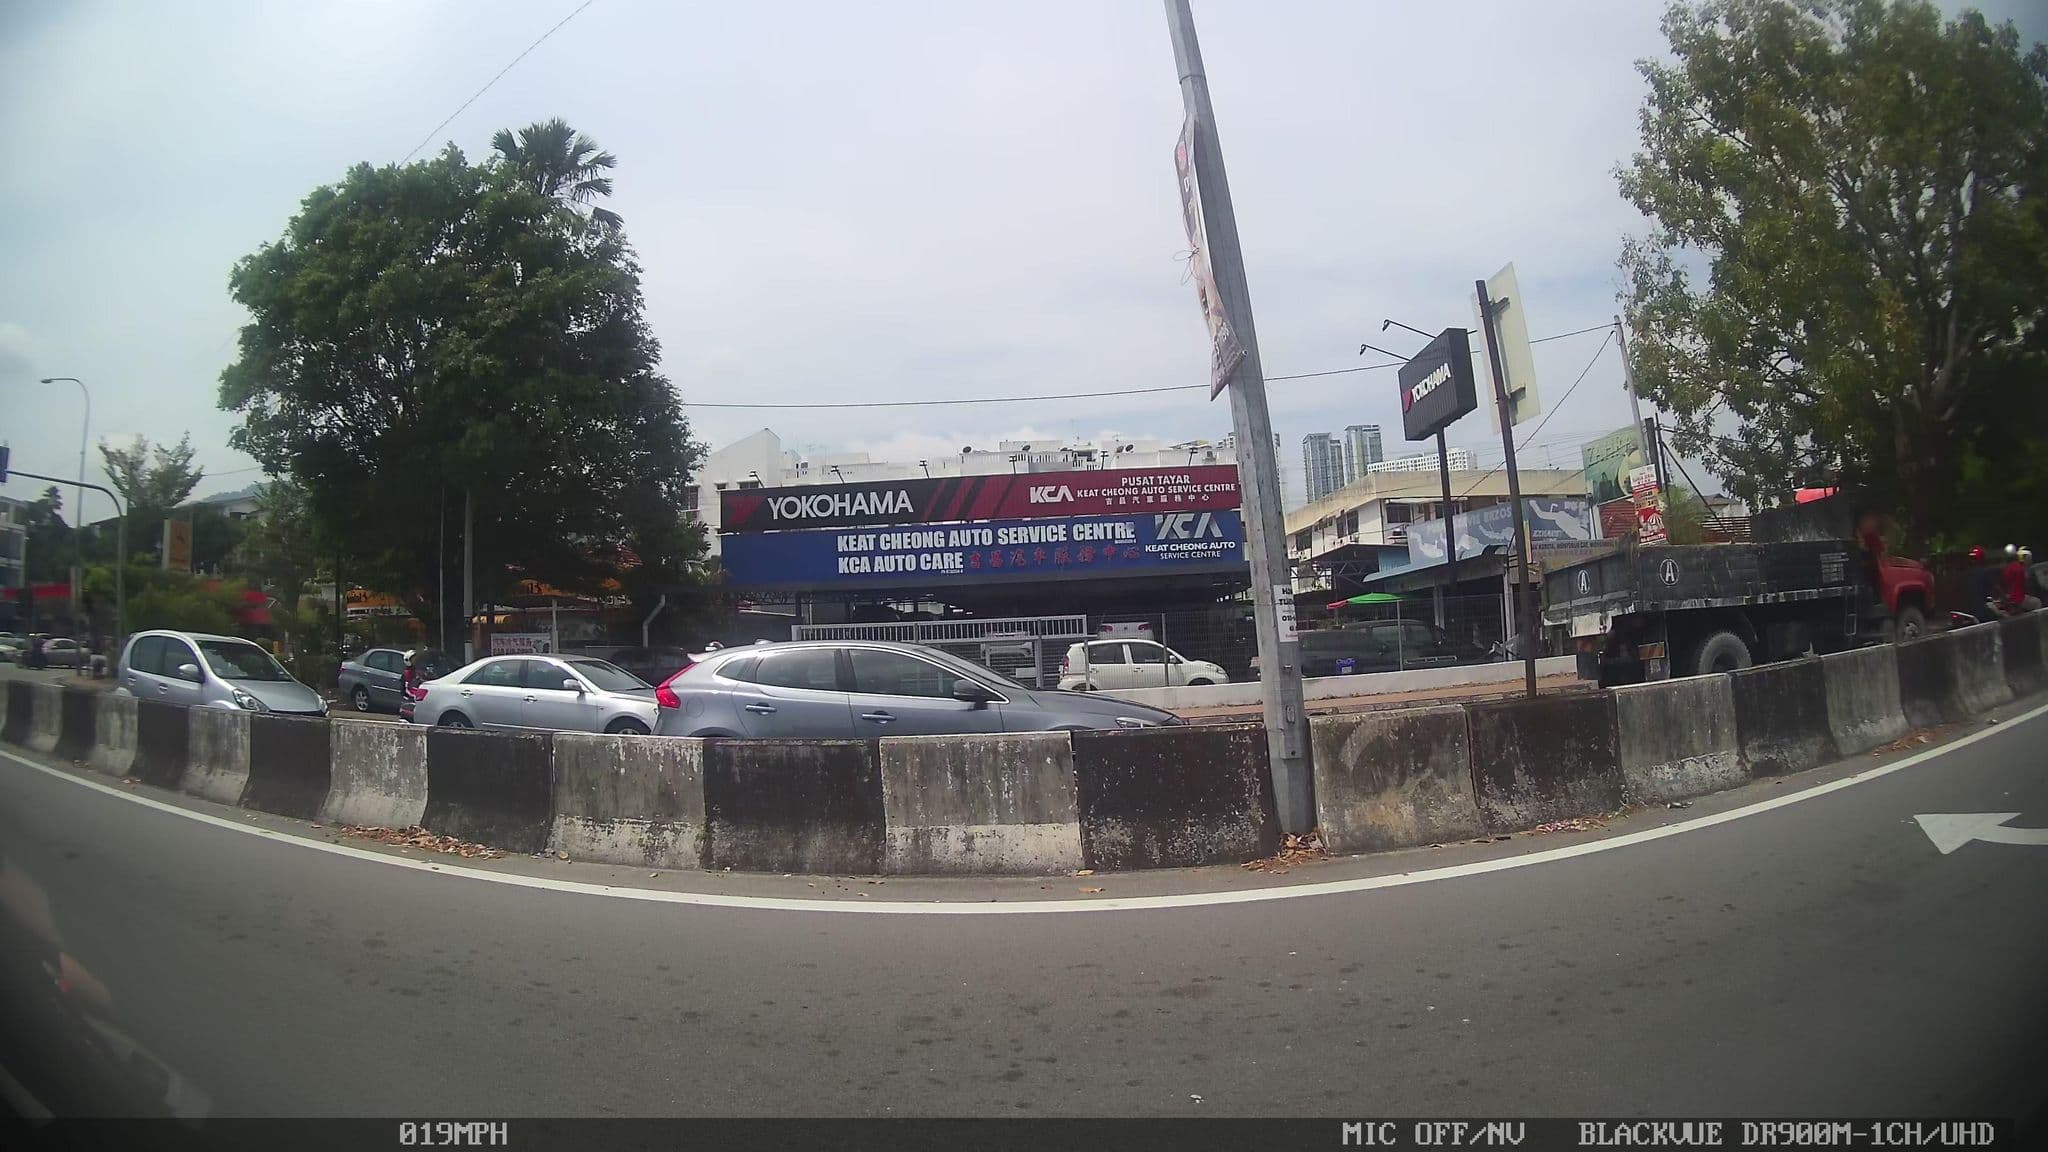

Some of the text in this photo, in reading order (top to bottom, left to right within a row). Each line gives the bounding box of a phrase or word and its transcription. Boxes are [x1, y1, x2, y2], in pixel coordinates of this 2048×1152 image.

[1411, 363, 1452, 403] YOKOHAMA
[1077, 483, 1236, 498] KEAT CHEONG AUTO SERVICE CENTRE
[1121, 474, 1190, 487] PUSAT TAYAR
[767, 490, 914, 520] YOKOHAMA
[1029, 485, 1075, 504] KCA
[1154, 511, 1223, 540] KCA
[837, 521, 1136, 552] KEAT CHEONG AUTO SERVICE CENTRE
[1145, 541, 1236, 553] KEAT CHEONG AUTO
[838, 551, 964, 574] KCA AUTO CARE
[1160, 550, 1221, 560] SERVICE CENTRE
